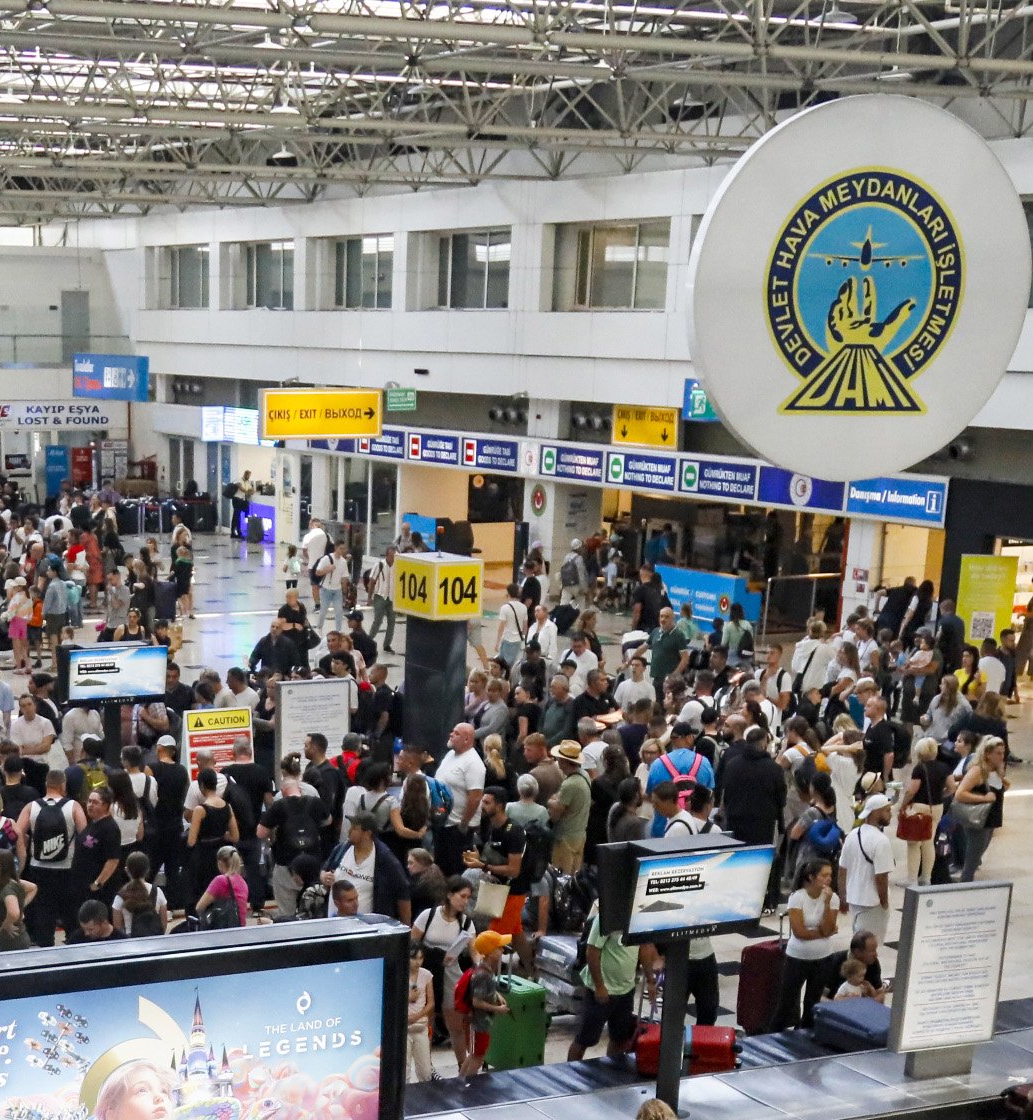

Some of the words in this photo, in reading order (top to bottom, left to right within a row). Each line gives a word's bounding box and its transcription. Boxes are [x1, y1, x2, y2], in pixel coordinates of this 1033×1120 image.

[818, 177, 949, 244] MEYDANLARI
[776, 208, 821, 270] HAVA
[905, 242, 957, 372] İŞLETMESİ
[771, 276, 811, 368] DEVLET
[26, 405, 65, 414] KAYIP
[69, 405, 100, 415] EŞYA
[268, 409, 291, 422] ÇIKIŞ
[300, 409, 316, 419] EXIT
[325, 408, 362, 419] ВЫХОД
[18, 416, 49, 425] LOST
[52, 416, 62, 425] &
[66, 416, 109, 425] FOUND
[624, 472, 645, 482] NOTHING
[651, 475, 674, 486] DECLARE
[704, 466, 734, 479] GÜMRÜKTEN
[735, 471, 751, 481] MUAF
[699, 480, 722, 492] NOTHING
[729, 483, 754, 495] DECLARE
[850, 487, 881, 503] Danışma
[888, 492, 926, 506] Information
[399, 571, 428, 604] 104
[438, 576, 478, 605] 104
[207, 716, 245, 726] CAUTION
[43, 833, 65, 854] NIKE
[265, 1024, 287, 1035] THE
[291, 1019, 322, 1032] LAND
[326, 1016, 342, 1028] OF
[242, 1030, 362, 1059] LEGENDS
